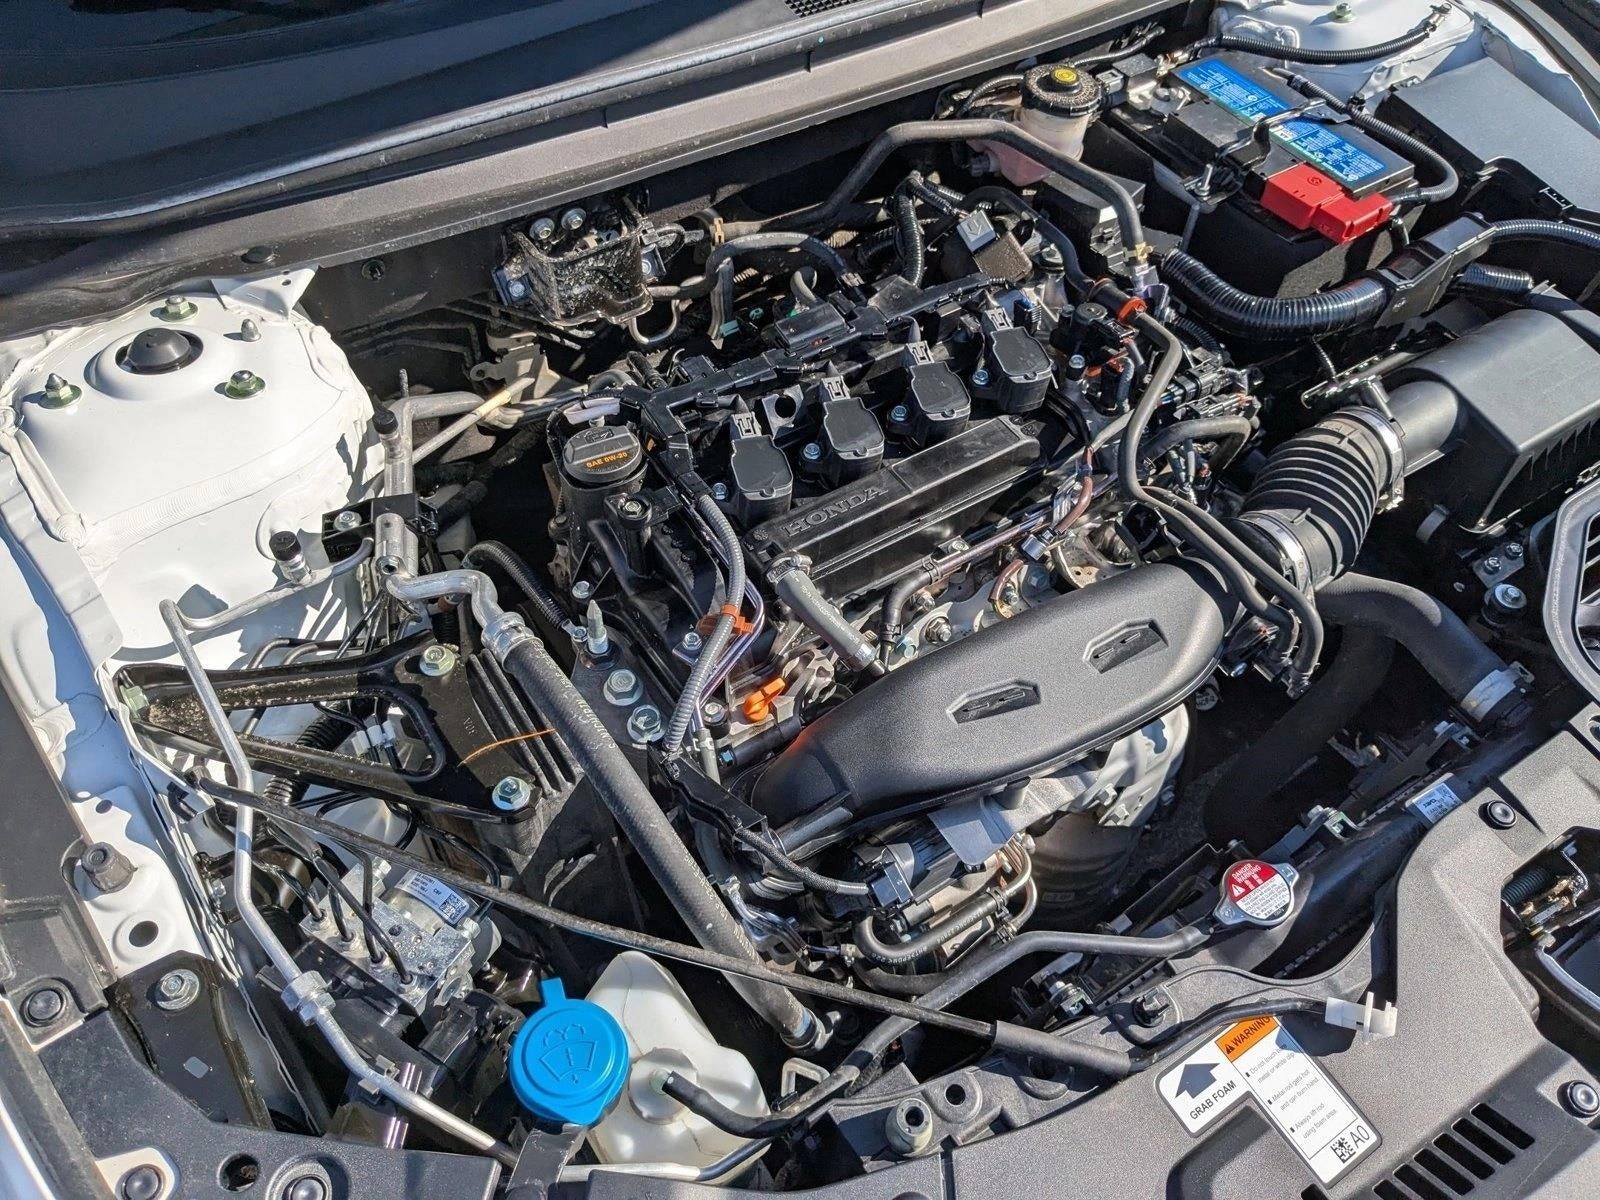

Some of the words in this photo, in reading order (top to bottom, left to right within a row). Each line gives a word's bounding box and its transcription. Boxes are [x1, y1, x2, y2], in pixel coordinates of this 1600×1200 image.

[586, 458, 604, 468] SAE
[604, 452, 628, 463] 0W-20
[782, 485, 888, 537] HONDA
[1232, 1016, 1270, 1049] WARNING
[1190, 1095, 1214, 1120] GRAB
[1212, 1080, 1237, 1104] FOAM
[1350, 1124, 1370, 1149] A0
